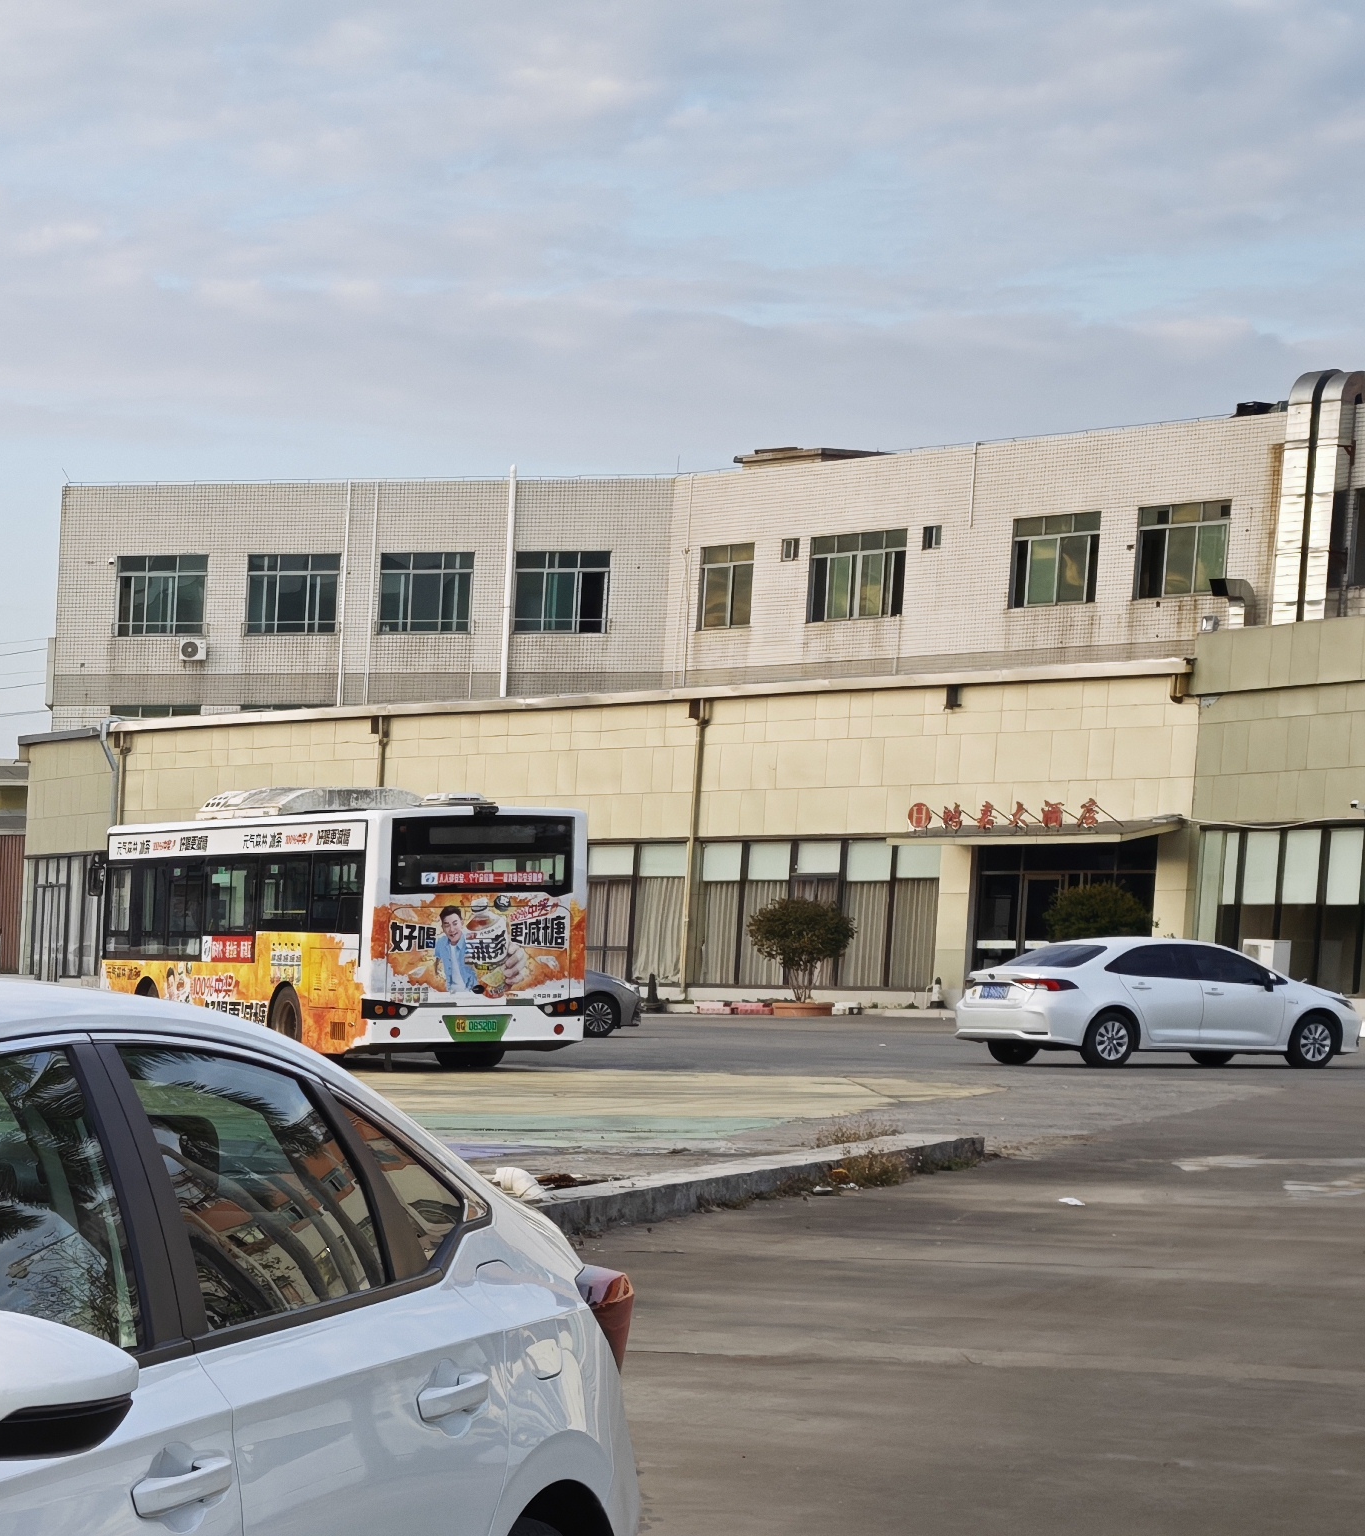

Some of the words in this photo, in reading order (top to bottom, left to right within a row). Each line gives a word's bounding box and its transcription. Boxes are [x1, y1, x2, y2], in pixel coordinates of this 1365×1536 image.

[390, 921, 436, 952] 好喝
[510, 915, 566, 946] 更减糖
